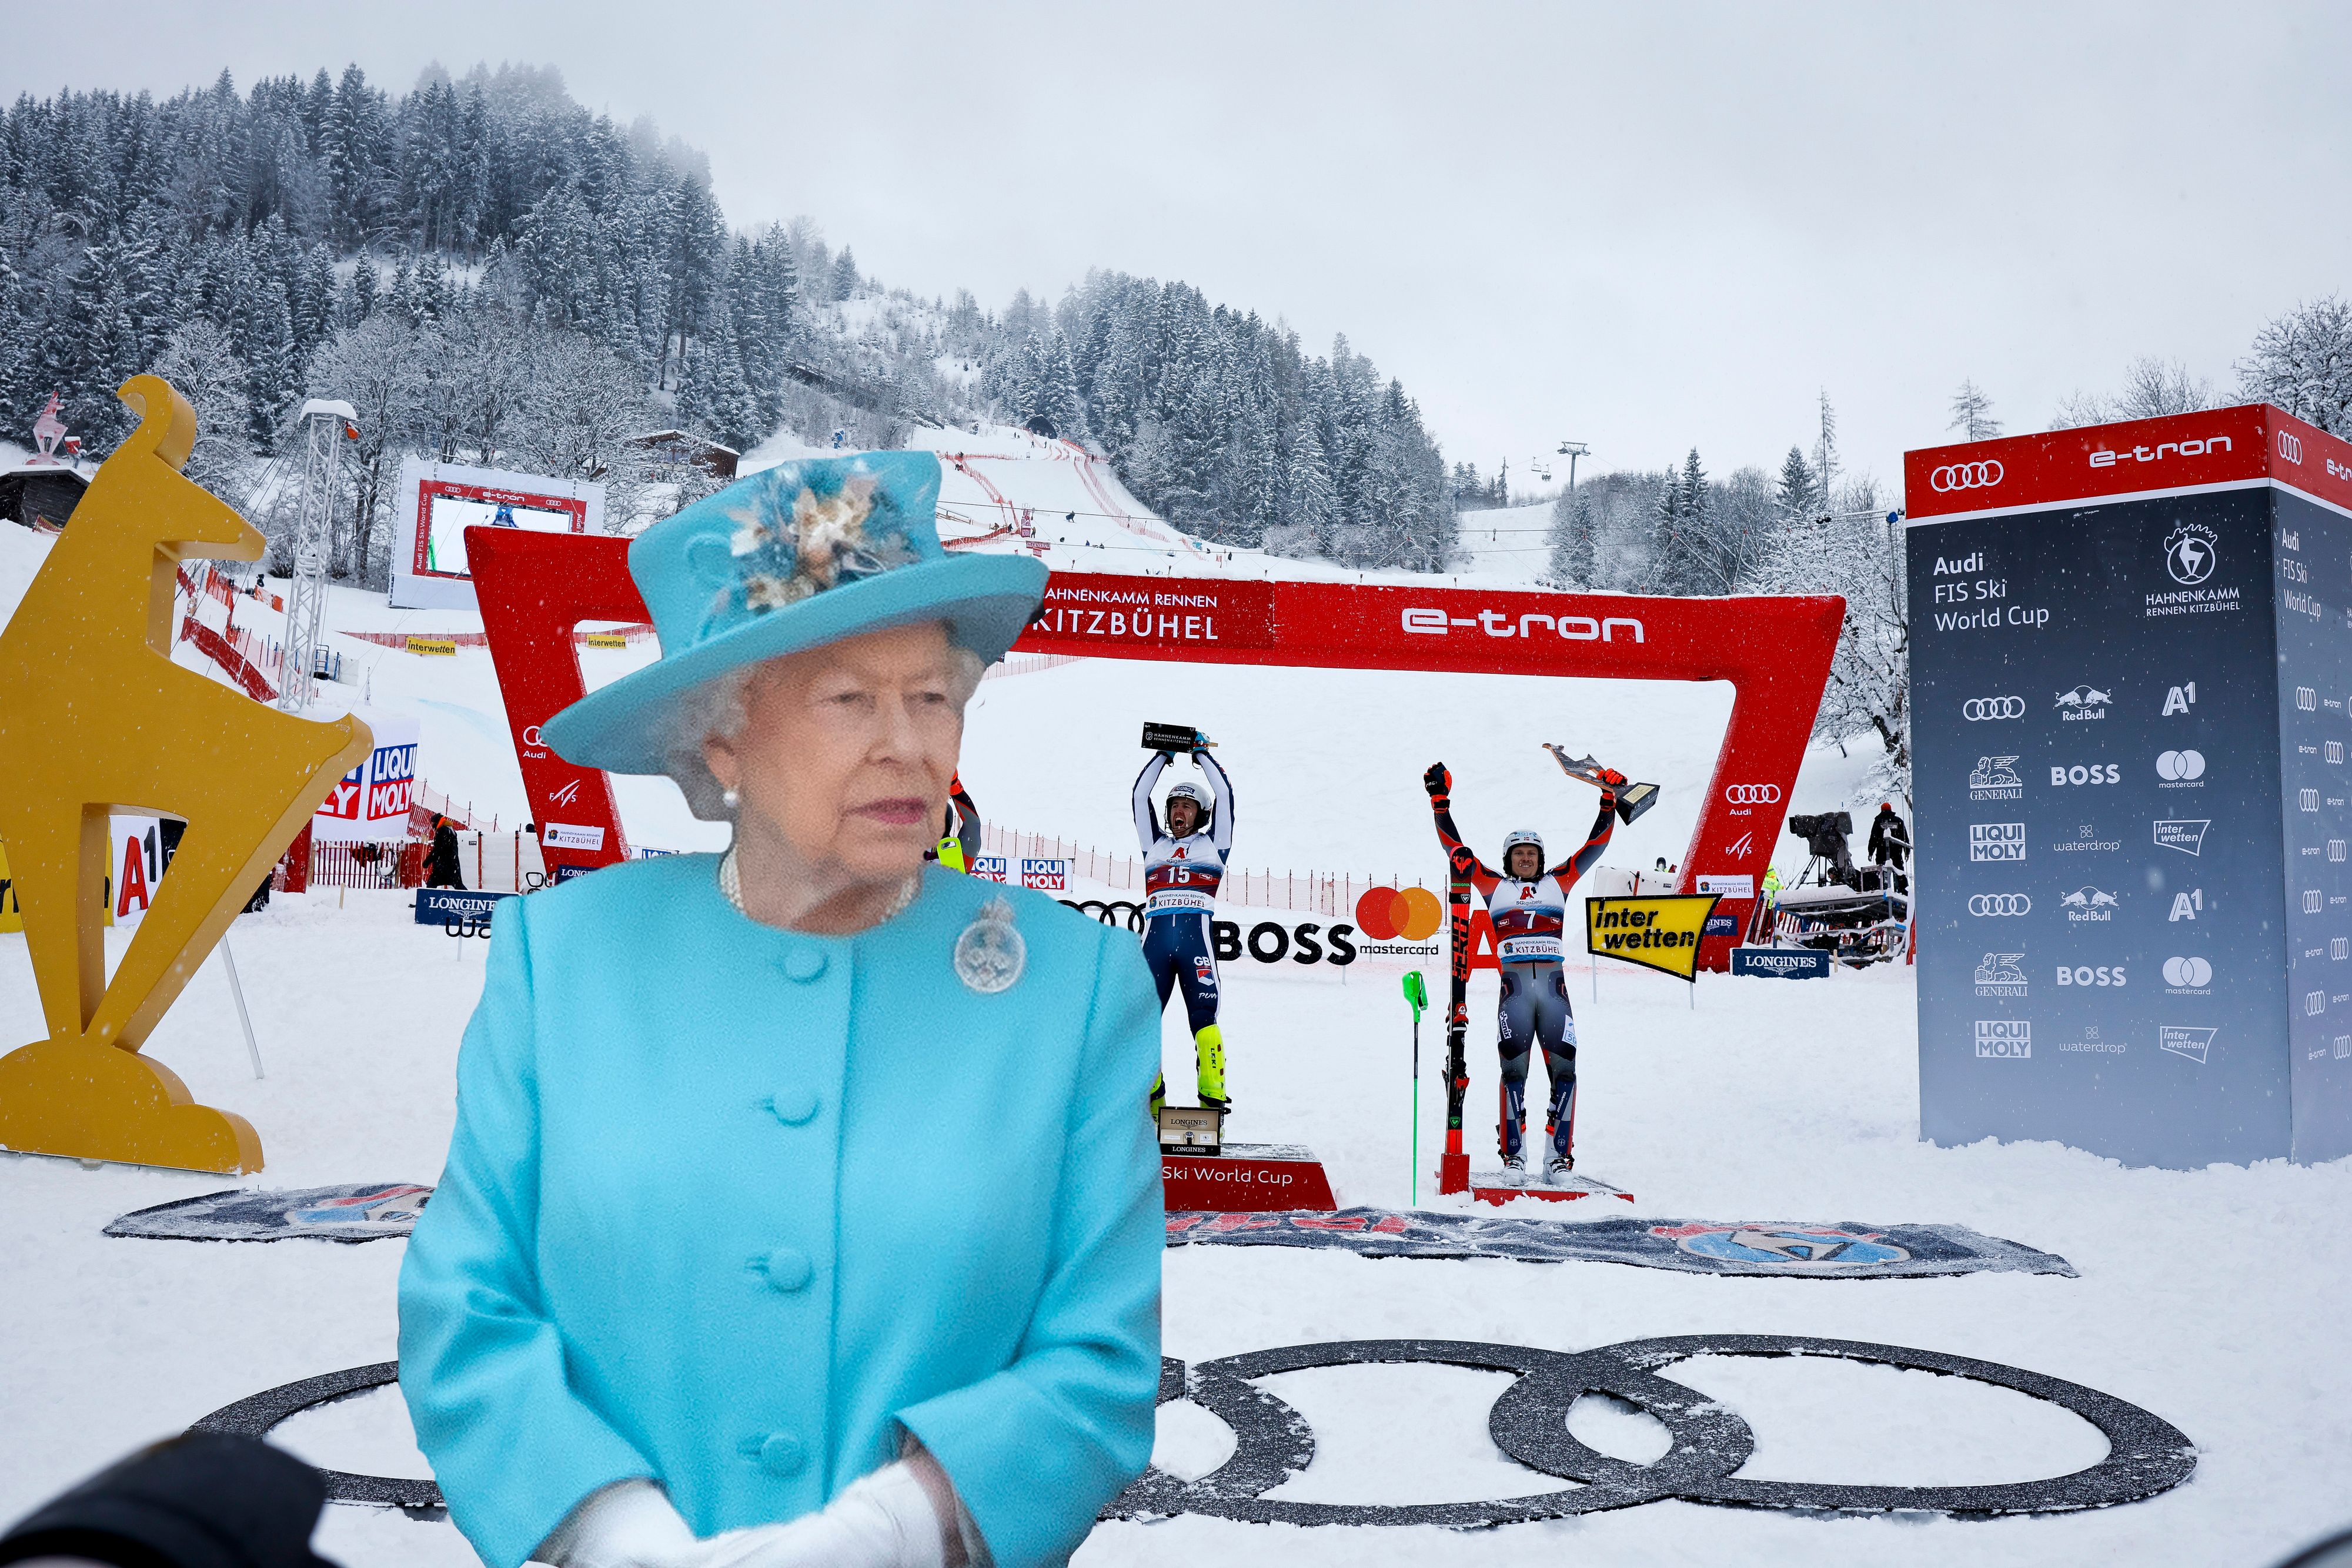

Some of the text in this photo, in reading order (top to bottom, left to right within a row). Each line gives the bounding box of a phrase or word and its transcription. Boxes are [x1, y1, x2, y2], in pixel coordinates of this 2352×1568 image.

[2090, 436, 2231, 467] e-tron
[2327, 458, 2352, 481] e-tr
[483, 492, 524, 502] e-tron
[2282, 528, 2299, 551] Audi
[1933, 552, 1983, 576] Audi
[2283, 559, 2307, 584] FIS Ski
[1043, 587, 1217, 608] AHNENKAMM RENNEN
[1935, 579, 2006, 603] FIS Ski
[2146, 587, 2240, 606] HAHNENKAMM
[2147, 600, 2240, 617] RENNEN KITZBÜHEL
[2284, 589, 2306, 613] World
[2308, 596, 2321, 622] Cup
[1033, 607, 1218, 640] KITZBÜHEL
[1401, 607, 1645, 643] e-tron
[1935, 606, 2049, 632] World Cup
[407, 640, 456, 654] interwetten
[588, 638, 626, 648] interwetten
[2161, 681, 2196, 717] A1
[2324, 698, 2341, 708] e-tron
[2063, 708, 2105, 721] Red Bull
[1154, 733, 1191, 741] HAHNENKAMM
[523, 750, 546, 759] Audi
[2298, 745, 2317, 754] e-tron
[375, 747, 417, 781] LIQUI
[2051, 764, 2120, 786] BOSS
[370, 781, 414, 817] MOLY
[549, 793, 577, 803] FIS
[1970, 788, 2023, 801] GENERALI
[2327, 797, 2344, 805] e-tron
[1973, 825, 2022, 842] LIQUI
[2157, 823, 2183, 834] inter
[559, 836, 600, 845] KITZBÜHEL
[2161, 834, 2199, 842] wetten
[1726, 847, 1752, 855] FIS
[1973, 843, 2024, 860] MOLY
[2053, 841, 2120, 852] waterdrop
[118, 825, 156, 917] A1
[971, 858, 1004, 872] QUI
[1024, 860, 1063, 875] LIQUI
[562, 868, 593, 877] LONG
[1168, 865, 1190, 884] 15
[1024, 875, 1064, 888] MOLY
[429, 897, 497, 911] LONGINE
[1158, 897, 1205, 907] KITZBÜHEL
[2169, 888, 2203, 922] A1
[2330, 896, 2347, 904] e-tron
[1524, 911, 1536, 929] 7
[1595, 901, 1659, 928] inter
[2069, 911, 2111, 921] Red Bull
[1707, 918, 1733, 927] INES
[1212, 921, 1357, 966] BOSS
[1604, 928, 1695, 950] wetten
[1360, 944, 1439, 955] mastercard
[1516, 944, 1560, 954] KITZBÜHEL
[2305, 948, 2323, 958] e-tron
[1194, 956, 1211, 967] GB
[1745, 955, 1817, 968] LONGINES
[2057, 966, 2127, 987] BOSS
[1975, 986, 2028, 997] GENERALI
[2333, 994, 2350, 1002] e-tron
[1500, 1011, 1511, 1039] phenix
[1977, 1022, 2027, 1039] LIQUI
[2164, 1028, 2190, 1040] inter
[1978, 1040, 2029, 1057] MOLY
[2059, 1042, 2126, 1055] waterdrop
[2167, 1039, 2205, 1050] wetten
[2308, 1048, 2326, 1060] e-tron
[1162, 1166, 1293, 1187] Ski World Cup
